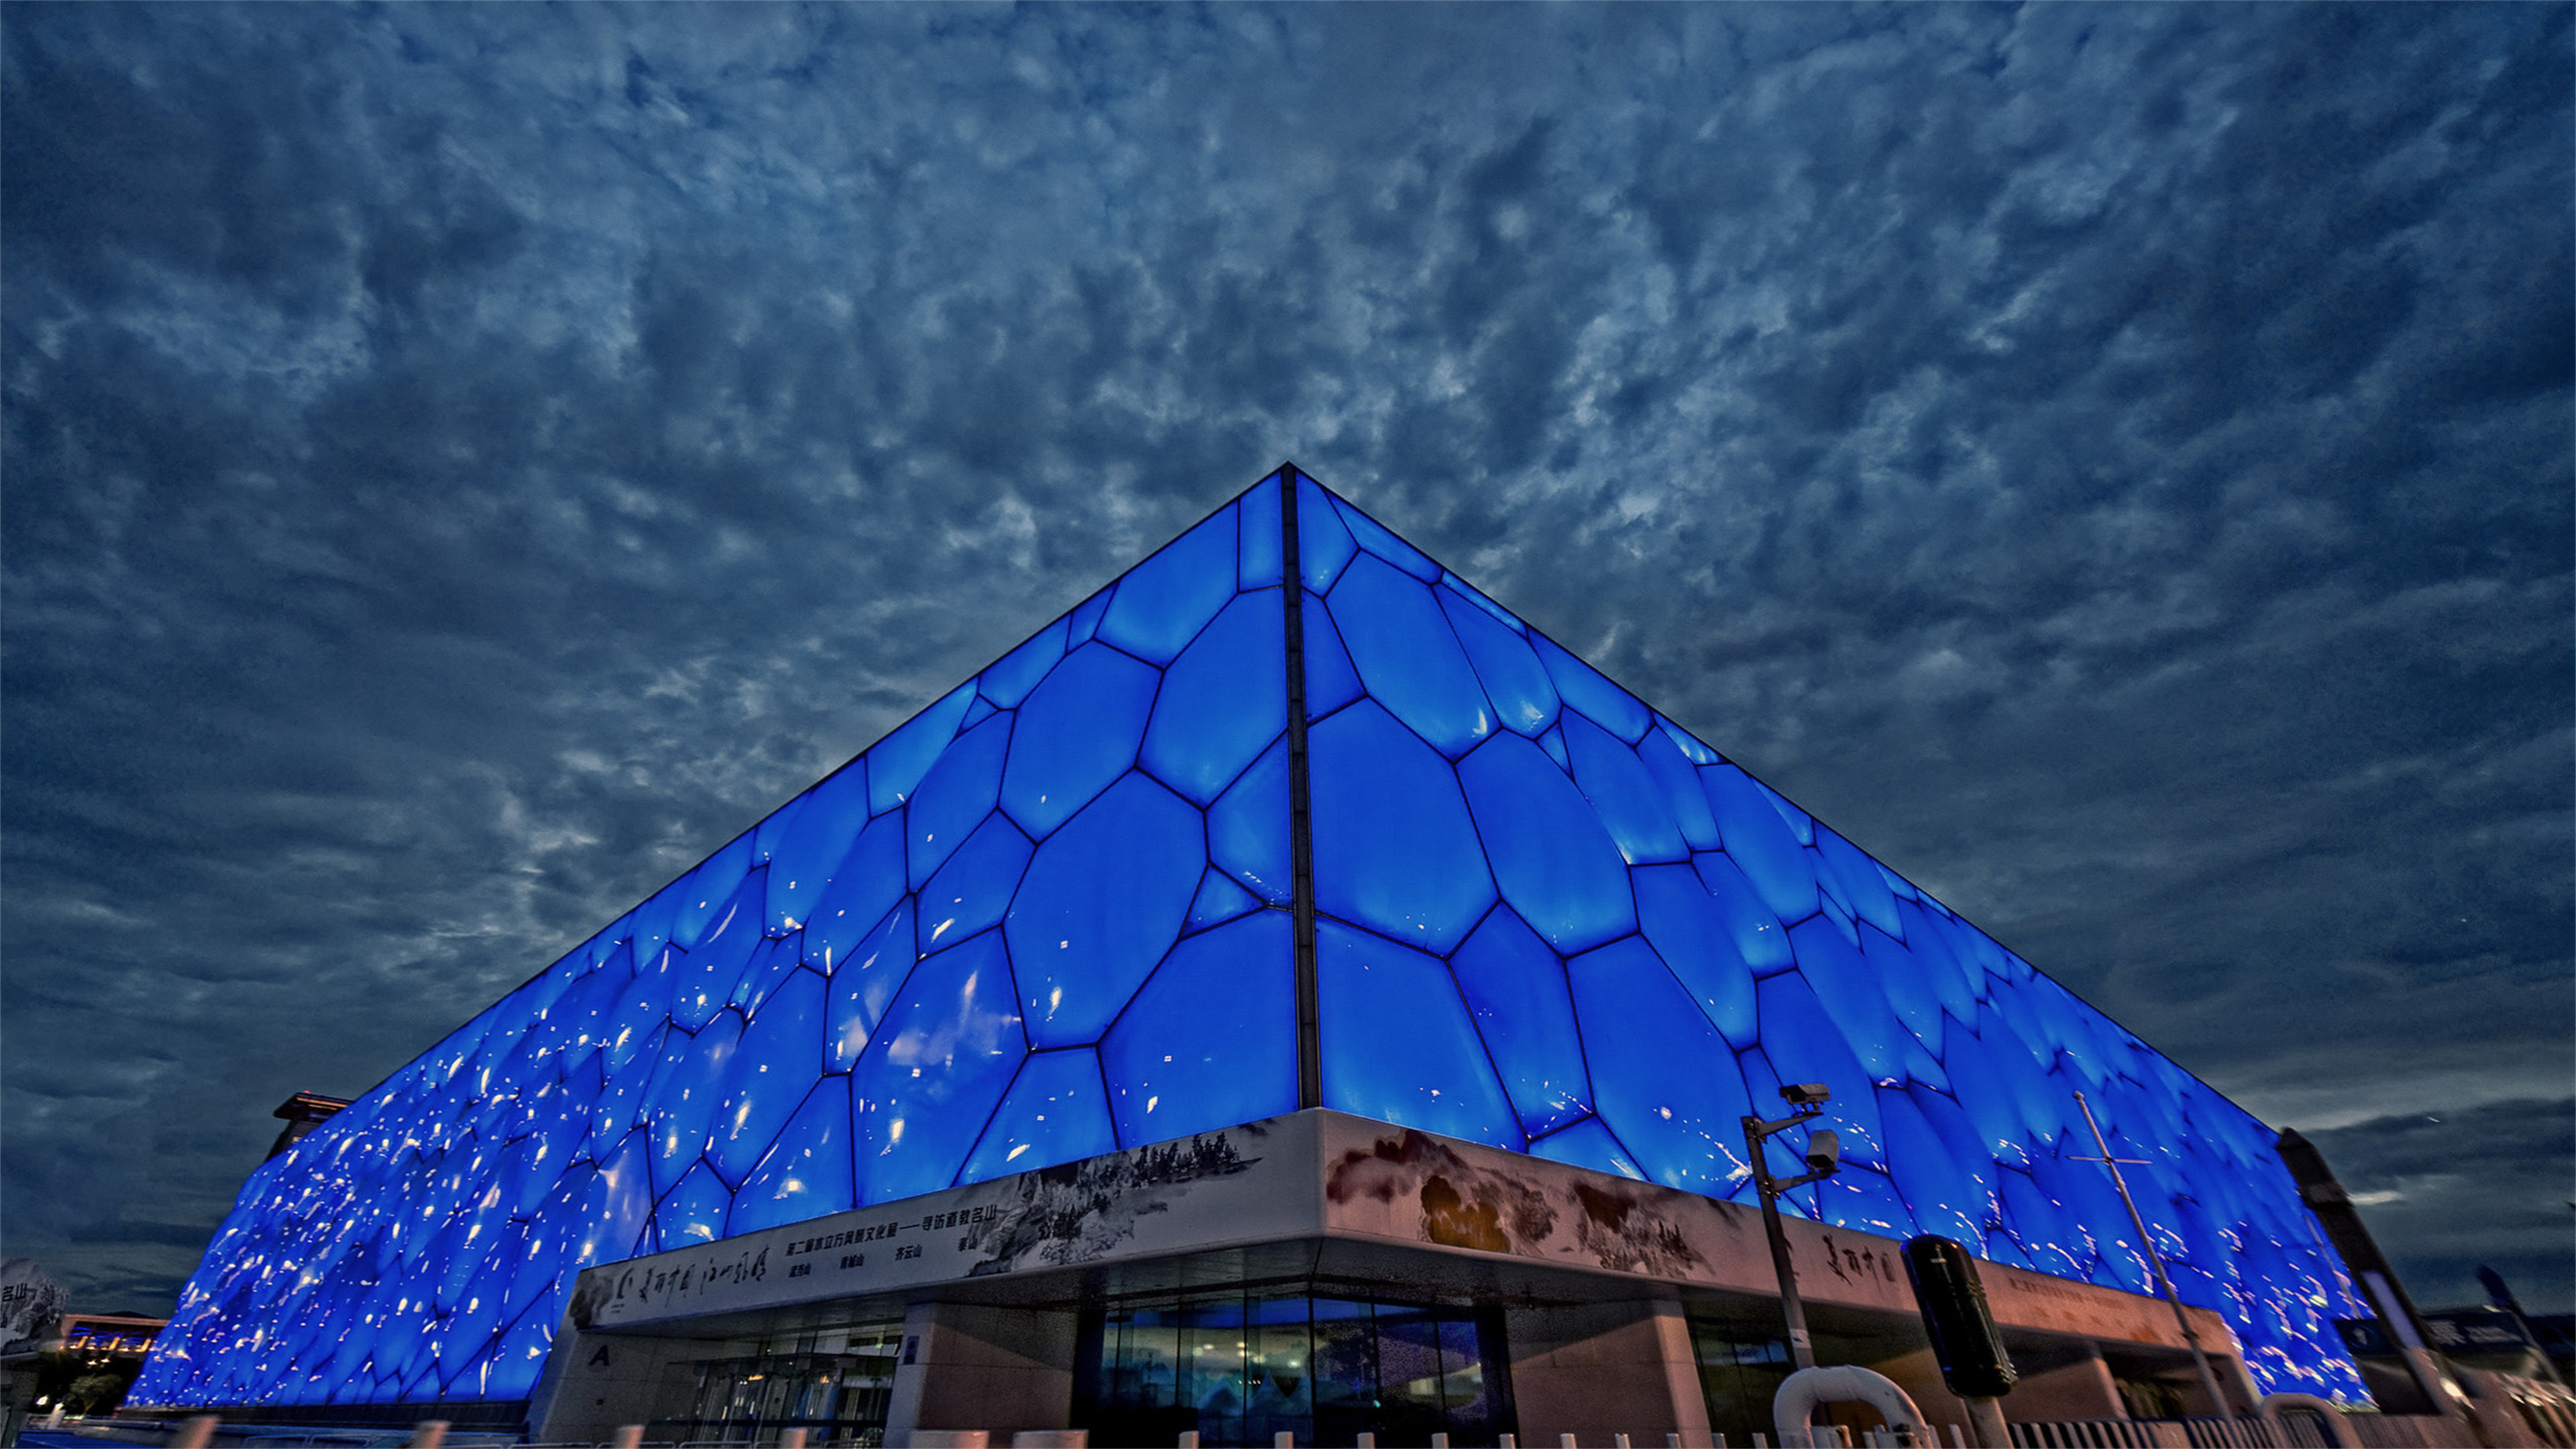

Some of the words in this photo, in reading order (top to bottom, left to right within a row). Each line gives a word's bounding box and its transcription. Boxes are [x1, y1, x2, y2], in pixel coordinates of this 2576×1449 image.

[895, 1244, 923, 1261] 齐云山
[588, 1344, 609, 1366] A
